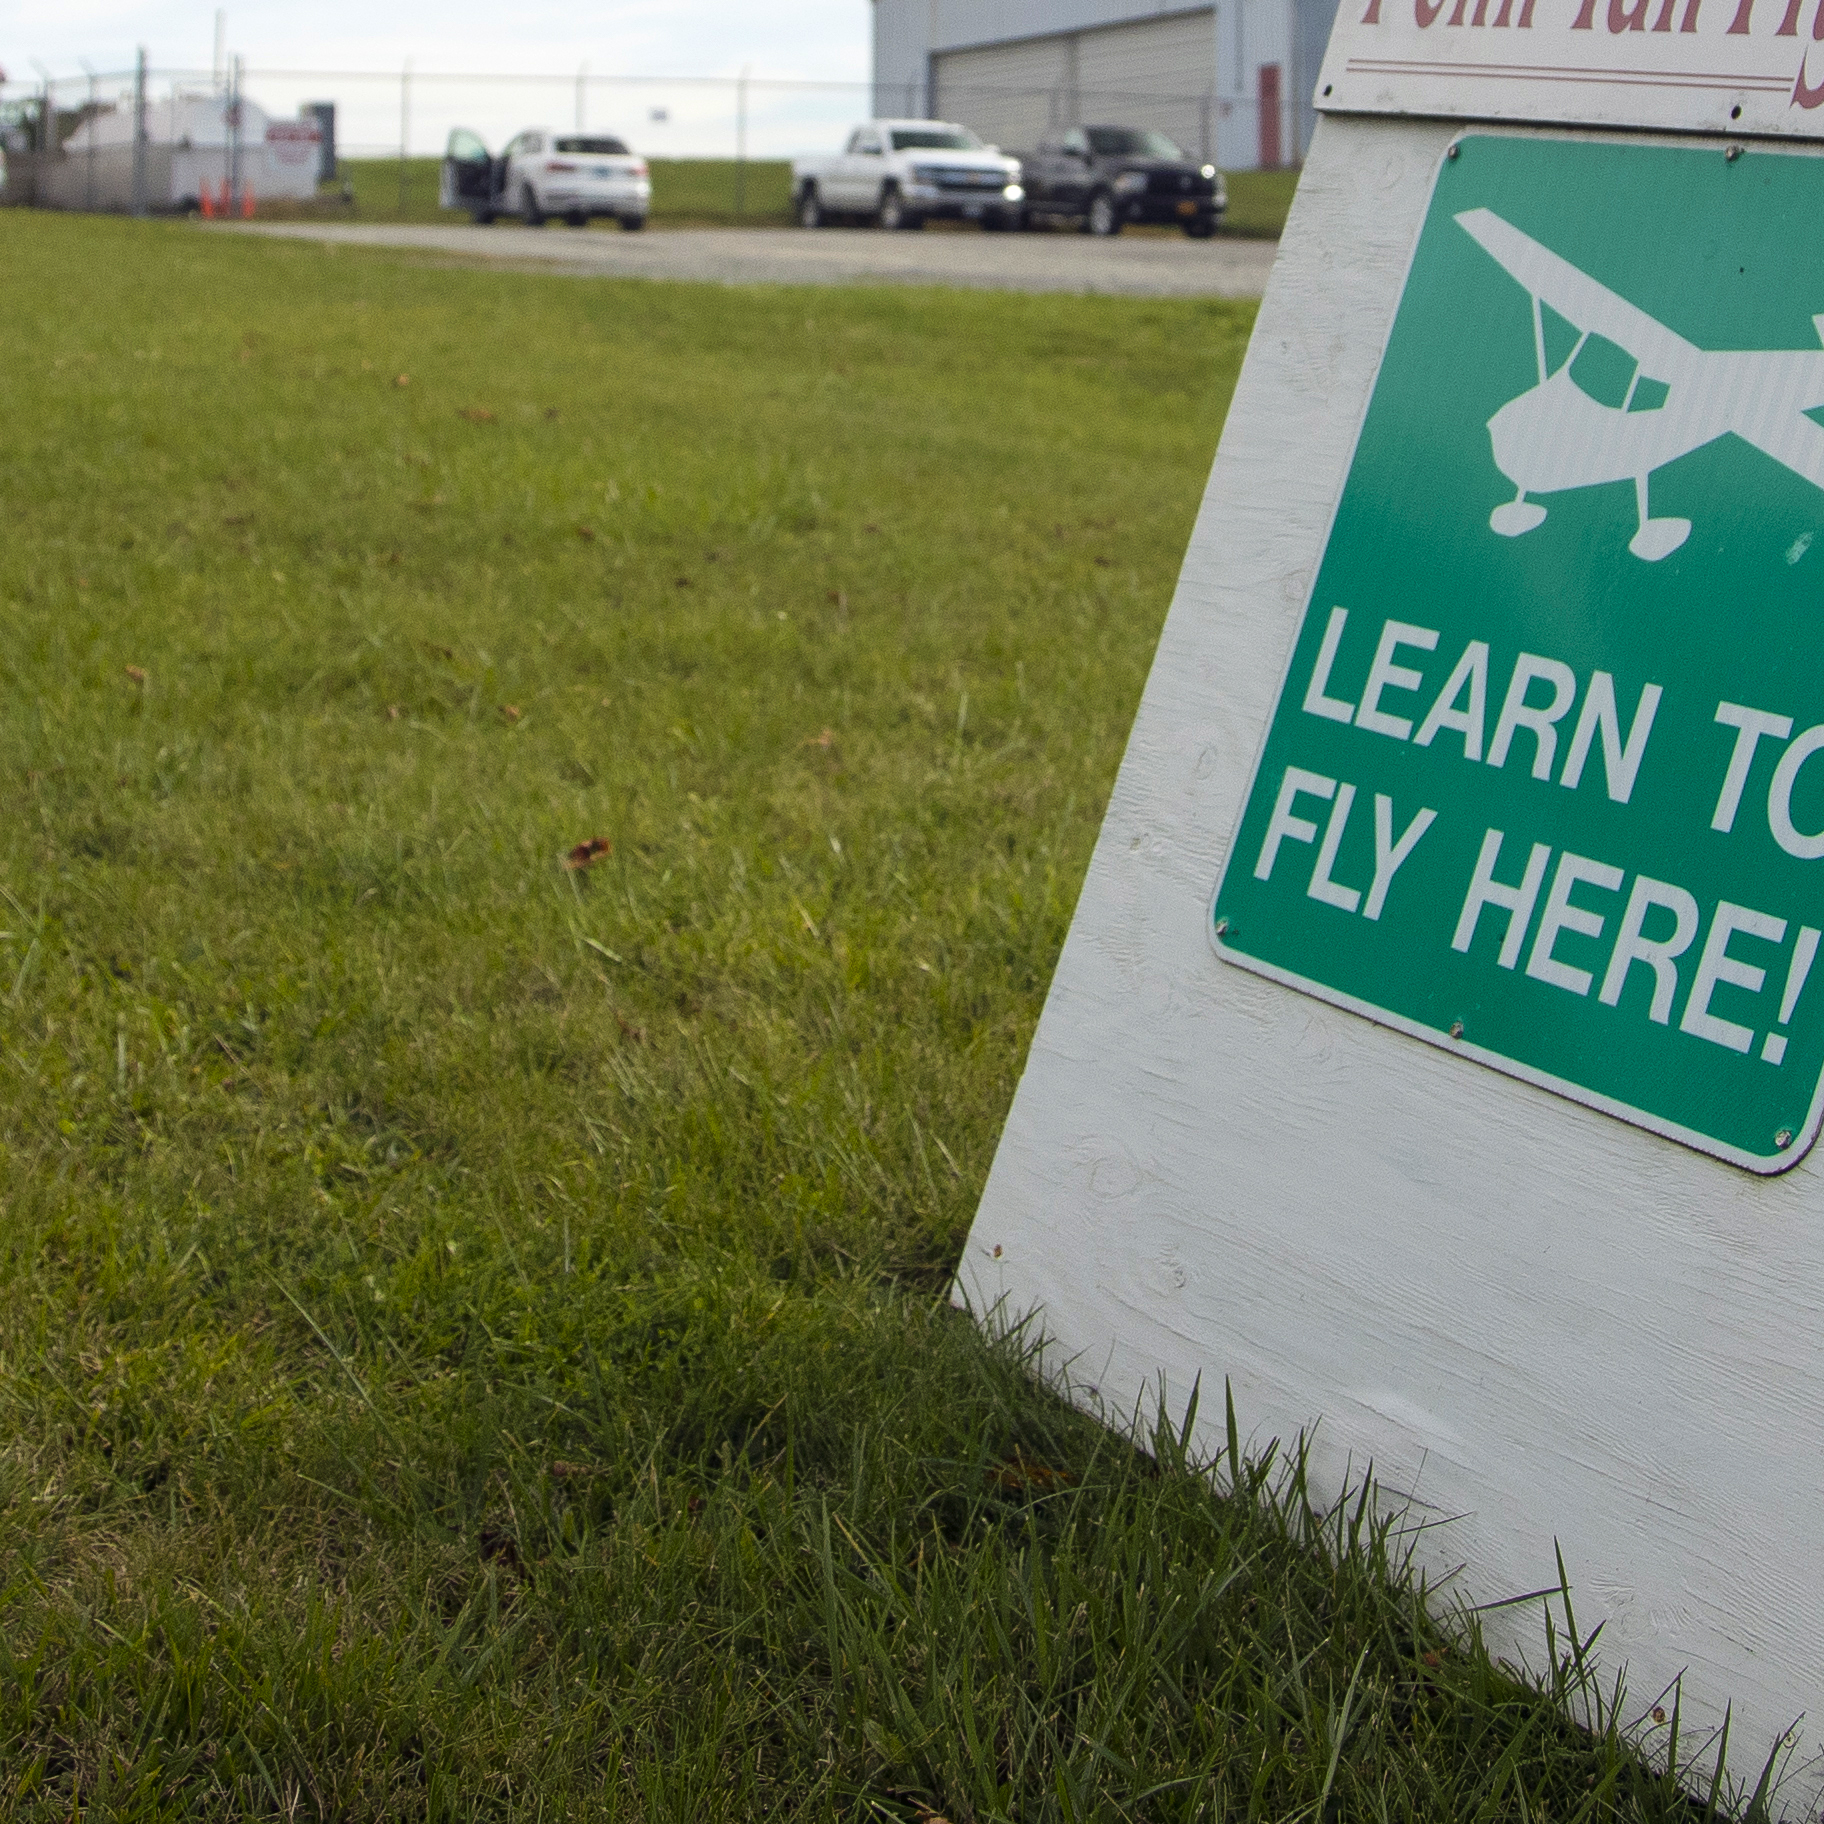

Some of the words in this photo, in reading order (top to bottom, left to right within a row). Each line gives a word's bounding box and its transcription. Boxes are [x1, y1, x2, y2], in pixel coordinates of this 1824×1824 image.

[1302, 606, 1663, 804] LEARN
[1253, 765, 1438, 921] FLY
[1451, 828, 1822, 1065] HERE!
